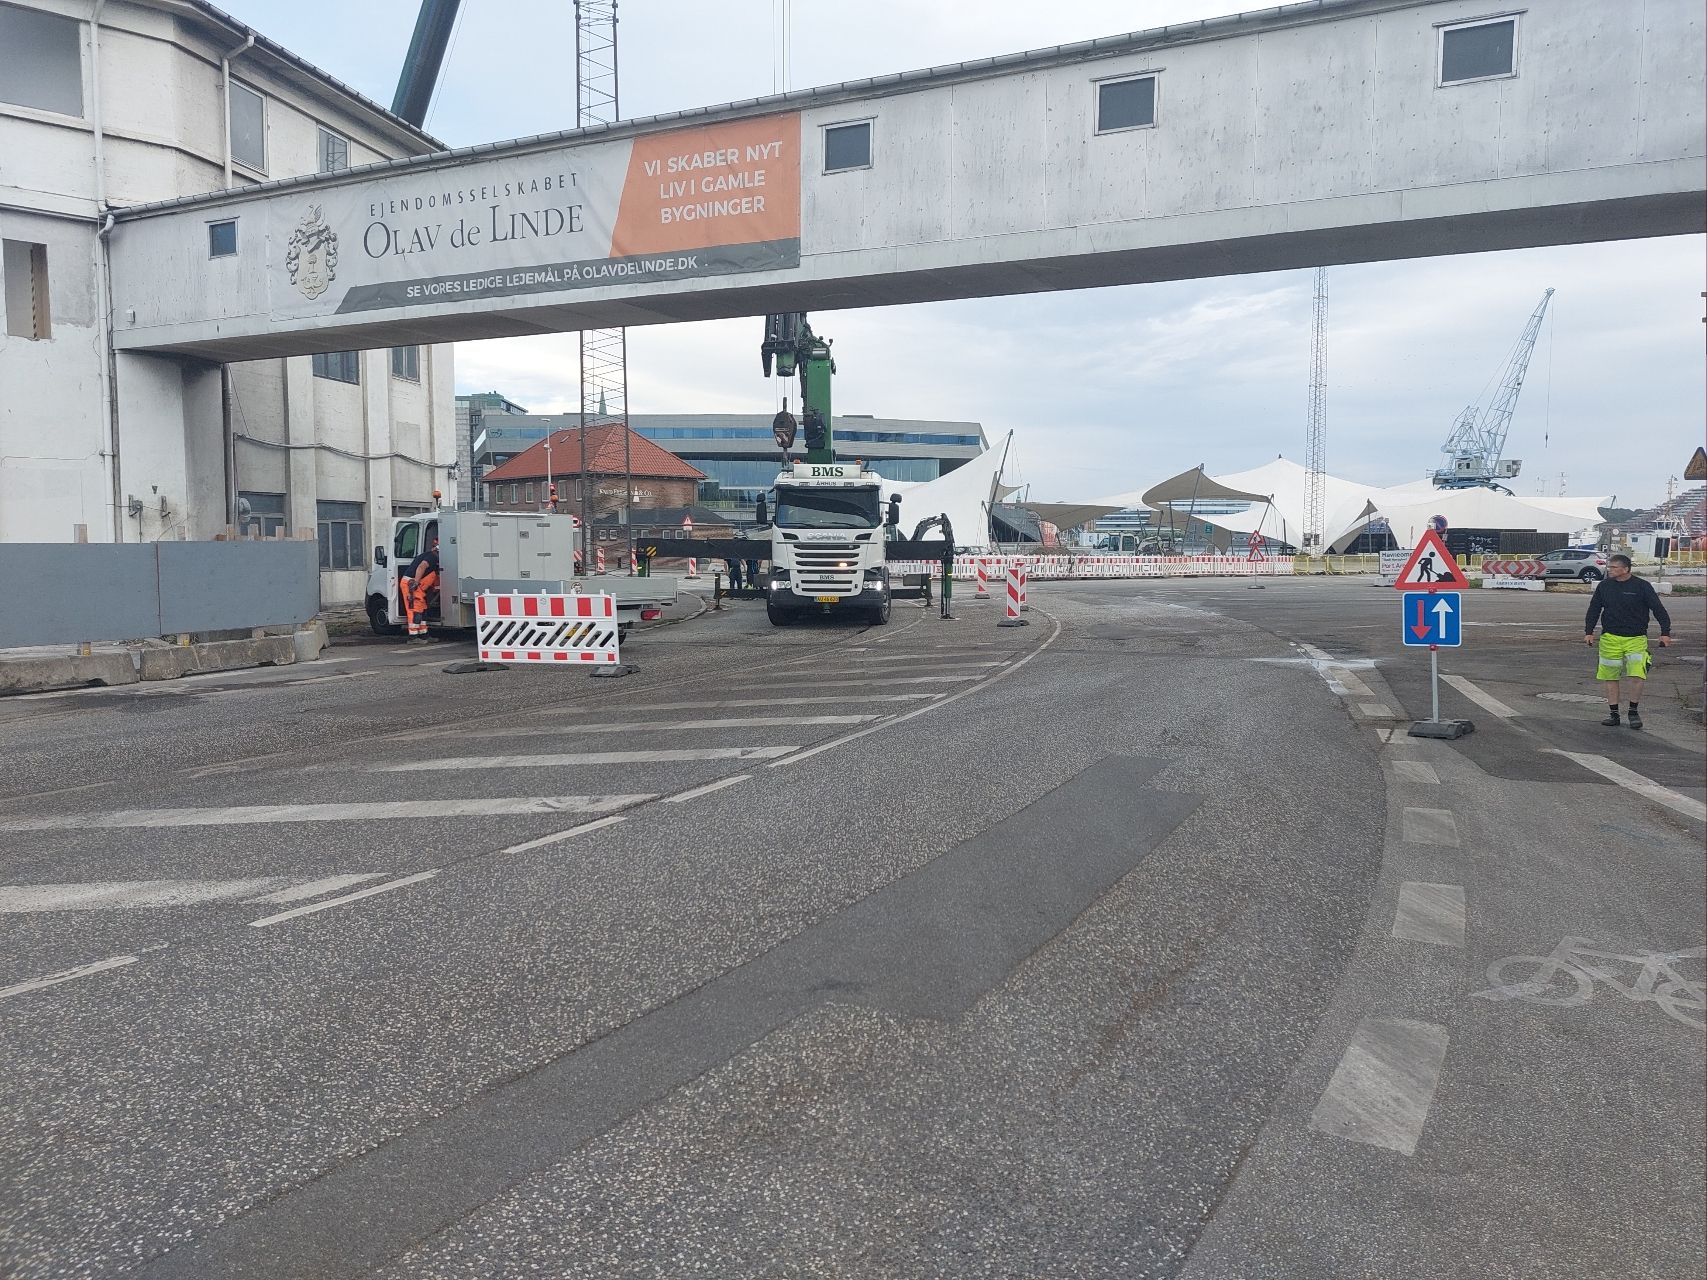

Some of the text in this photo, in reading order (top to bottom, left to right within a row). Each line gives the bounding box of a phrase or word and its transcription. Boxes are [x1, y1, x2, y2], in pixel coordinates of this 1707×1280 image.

[644, 141, 783, 177] VI SKABER NYT
[370, 172, 578, 218] EJENDOMSSELSKABET
[660, 169, 766, 199] LIV I GAMLE
[661, 195, 765, 224] BYGNINGER
[363, 204, 584, 258] OLAV de LINDE
[406, 255, 698, 298] SE VORES LEDIGE LEJEMÅL PÅ OLAVDELINDE.DK
[811, 466, 844, 477] BMS
[807, 532, 847, 541] SCANIA
